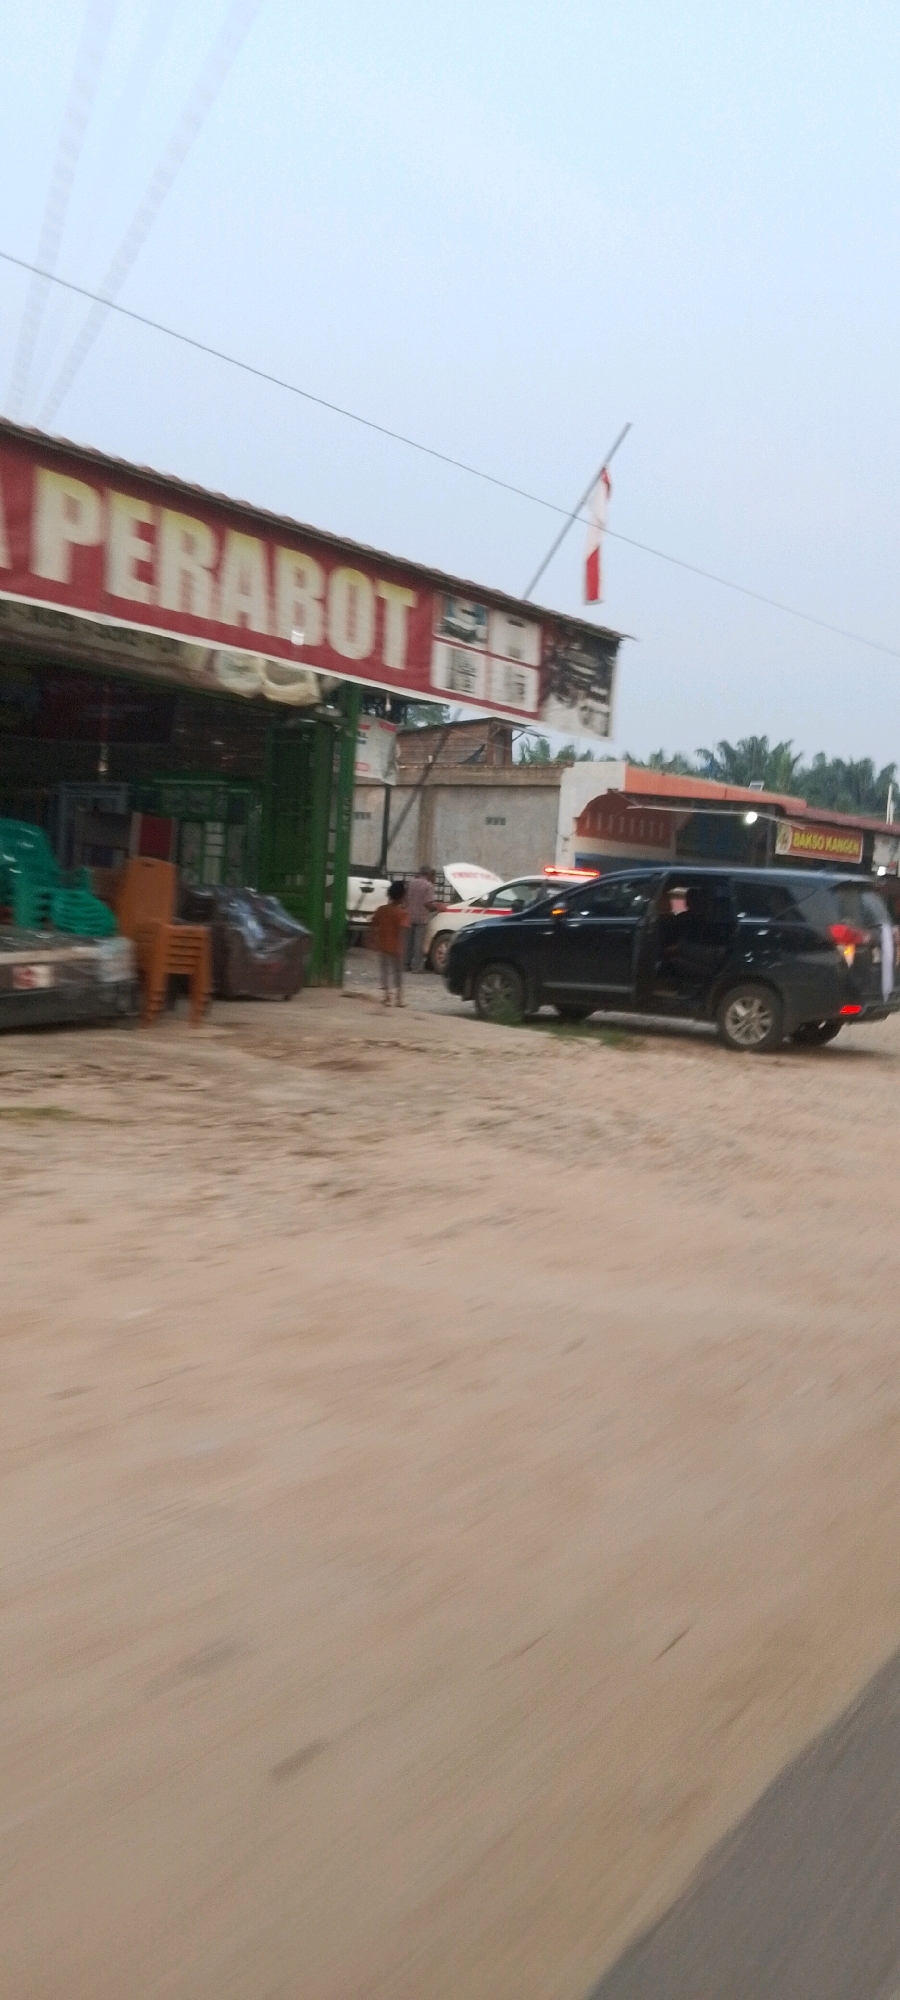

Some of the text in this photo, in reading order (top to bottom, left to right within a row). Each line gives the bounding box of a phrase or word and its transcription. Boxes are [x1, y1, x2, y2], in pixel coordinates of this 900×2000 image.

[29, 465, 418, 669] PERABOT
[793, 831, 860, 855] BAKSO KANGEN
